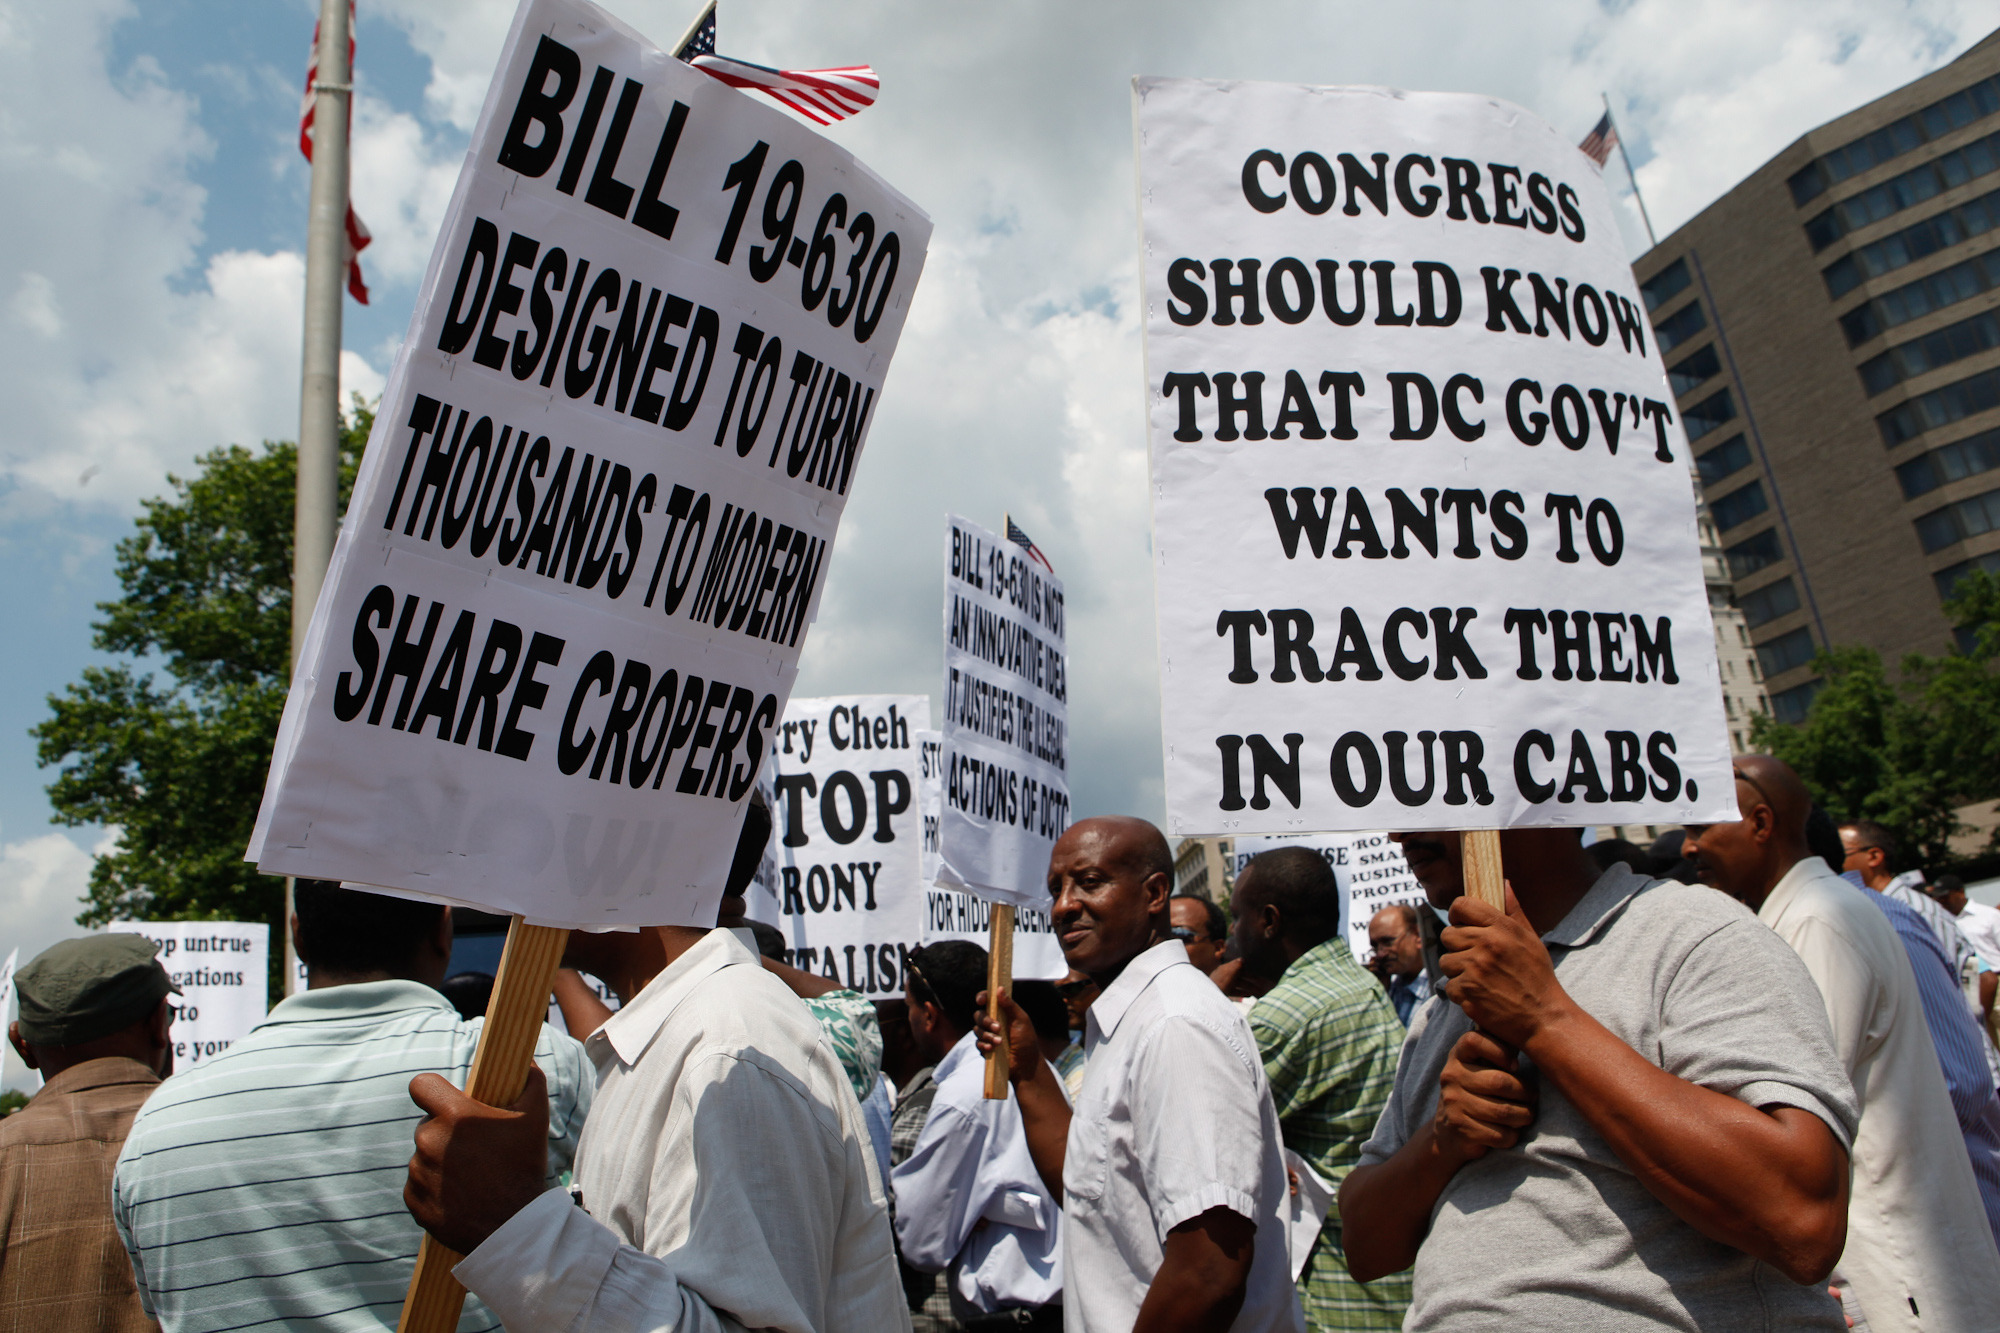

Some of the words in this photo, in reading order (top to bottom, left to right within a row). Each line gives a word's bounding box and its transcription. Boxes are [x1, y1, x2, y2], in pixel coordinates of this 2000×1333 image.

[497, 34, 690, 240] BILL
[715, 140, 899, 343] 19-630
[1241, 149, 1586, 243] CONGRESS
[1167, 257, 1462, 327] SHOULD
[1480, 266, 1647, 358] KNOW
[438, 216, 719, 432] DESIGNED
[714, 322, 781, 457] TO
[768, 351, 874, 495] TURN
[1162, 369, 1365, 443] THAT
[1386, 373, 1486, 442] DC
[1505, 378, 1674, 463] GOV'T
[384, 394, 656, 599] THOUSANDS
[644, 484, 709, 616] TO
[689, 503, 826, 648] MODERN
[1264, 486, 1528, 560] WANTS
[1544, 492, 1624, 567] TO
[952, 525, 983, 590] BILL
[989, 546, 1029, 614] 19-630
[1032, 571, 1041, 623] IS
[1044, 581, 1064, 639] NOT
[951, 594, 970, 652] AN
[973, 604, 1043, 688] INNOVATIVE
[1046, 644, 1066, 704] IDEA
[1216, 606, 1488, 684] TRACK
[1503, 608, 1680, 685] THEM
[333, 584, 566, 762] SHARE
[557, 650, 777, 802] CROPERS
[829, 704, 909, 751] Cheh
[948, 666, 959, 722] IT
[960, 673, 1014, 744] JUSTIFIES
[1017, 695, 1033, 753] THE
[1035, 706, 1065, 771] ILLEGAL
[922, 741, 942, 779] ST
[949, 751, 1017, 826] ACTIONS
[1021, 776, 1037, 832] OF
[1215, 733, 1304, 811] IN
[1330, 730, 1494, 808] OUR
[1513, 728, 1699, 804] CABS.
[779, 862, 881, 915] RONY
[957, 894, 991, 932] HIDD
[1014, 905, 1056, 933] AGEN
[169, 967, 244, 989] gations
[184, 935, 251, 953] untrue
[178, 1004, 198, 1021] to
[193, 1040, 234, 1062] you
